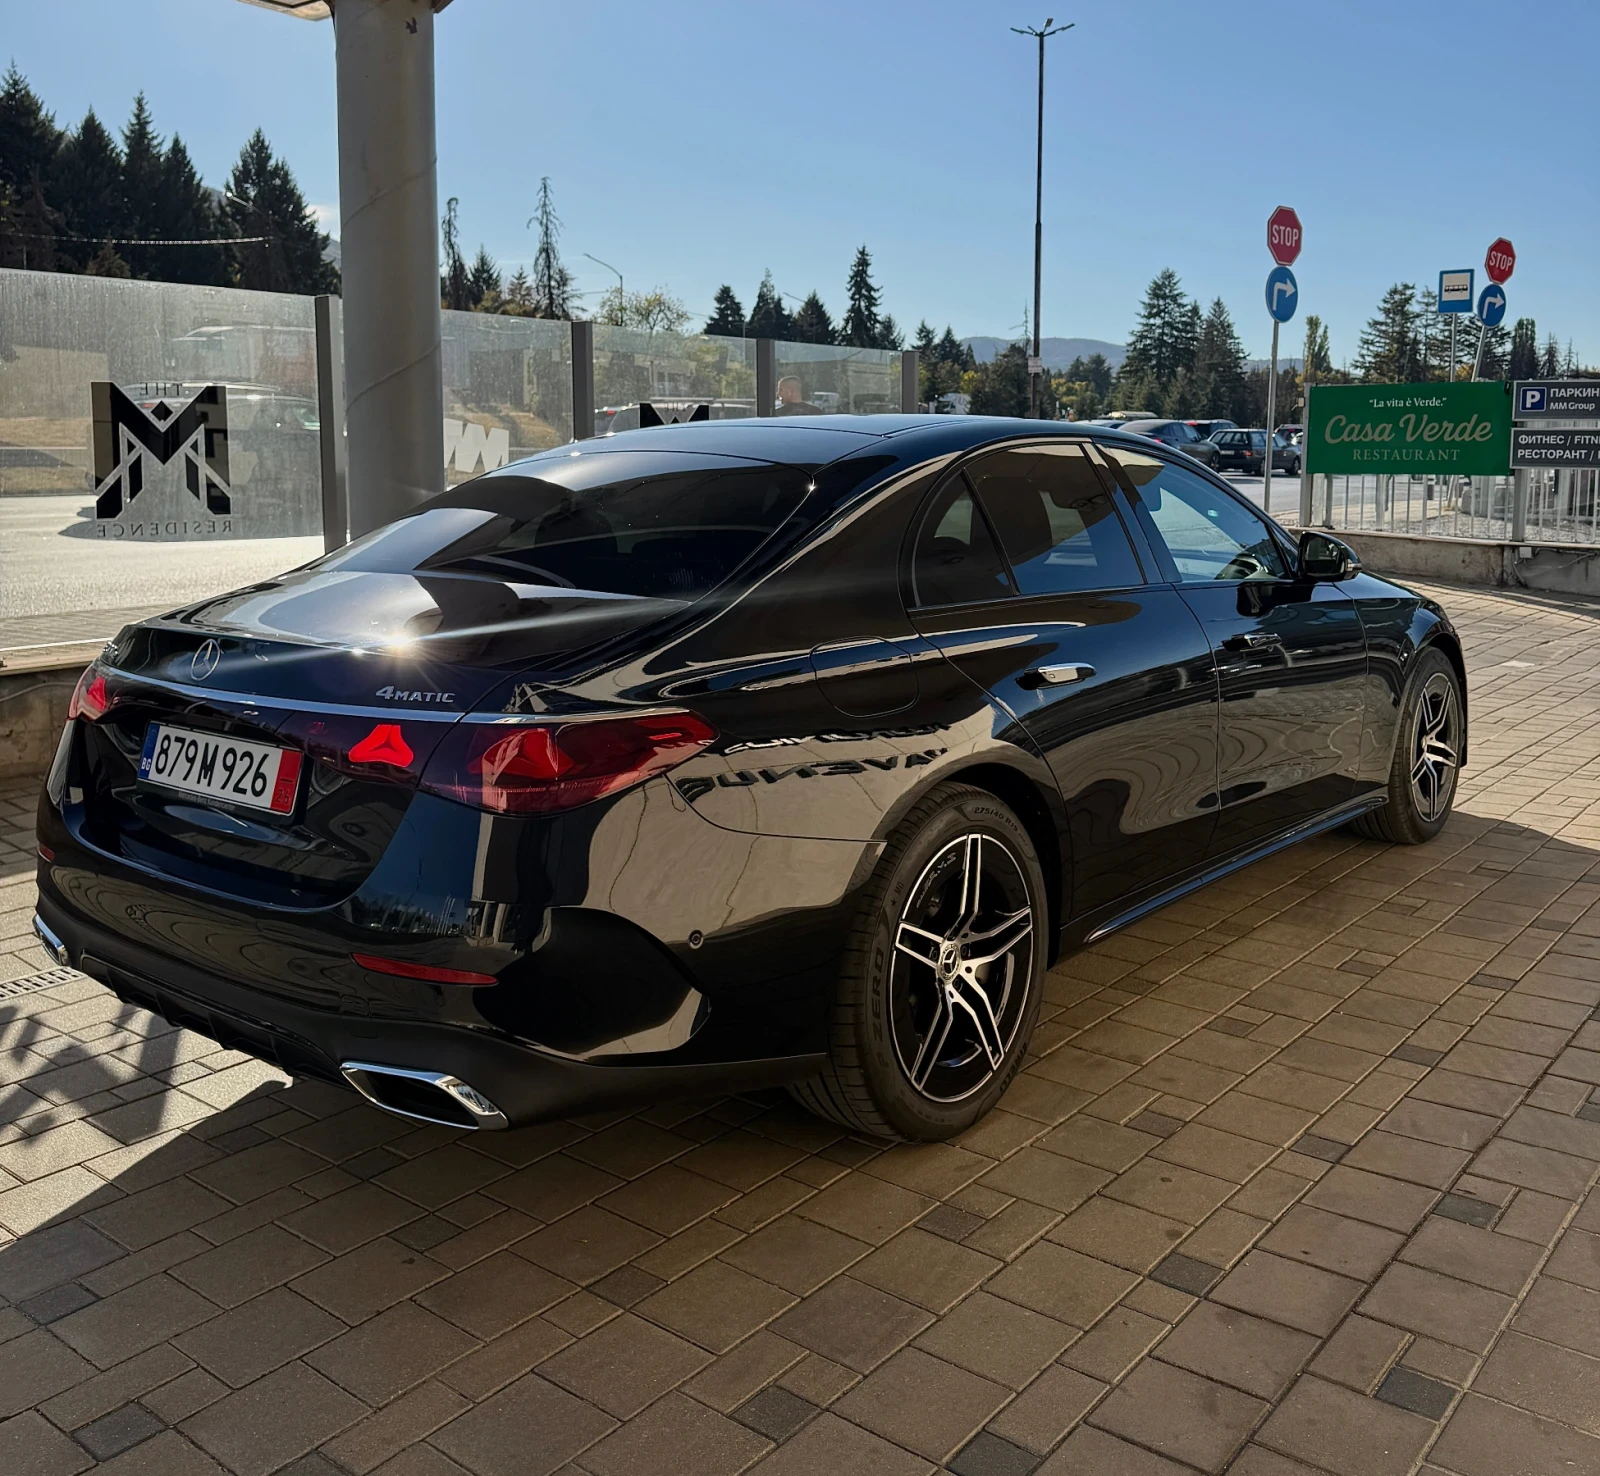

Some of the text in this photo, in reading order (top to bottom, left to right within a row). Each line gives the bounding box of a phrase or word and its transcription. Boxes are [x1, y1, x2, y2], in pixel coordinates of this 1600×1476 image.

[1272, 224, 1299, 247] STOP
[1489, 251, 1513, 271] STOP
[1386, 398, 1404, 407] vita
[1568, 402, 1595, 411] Group
[1324, 413, 1493, 444] Casa Verde
[1518, 434, 1565, 445] ФИТНЕС
[1353, 449, 1461, 461] RESTAURANT
[1517, 449, 1588, 459] РЕСТОРАНТ
[375, 685, 456, 703] 4MATIC
[141, 757, 152, 771] BG
[871, 947, 885, 1042] ZERO
